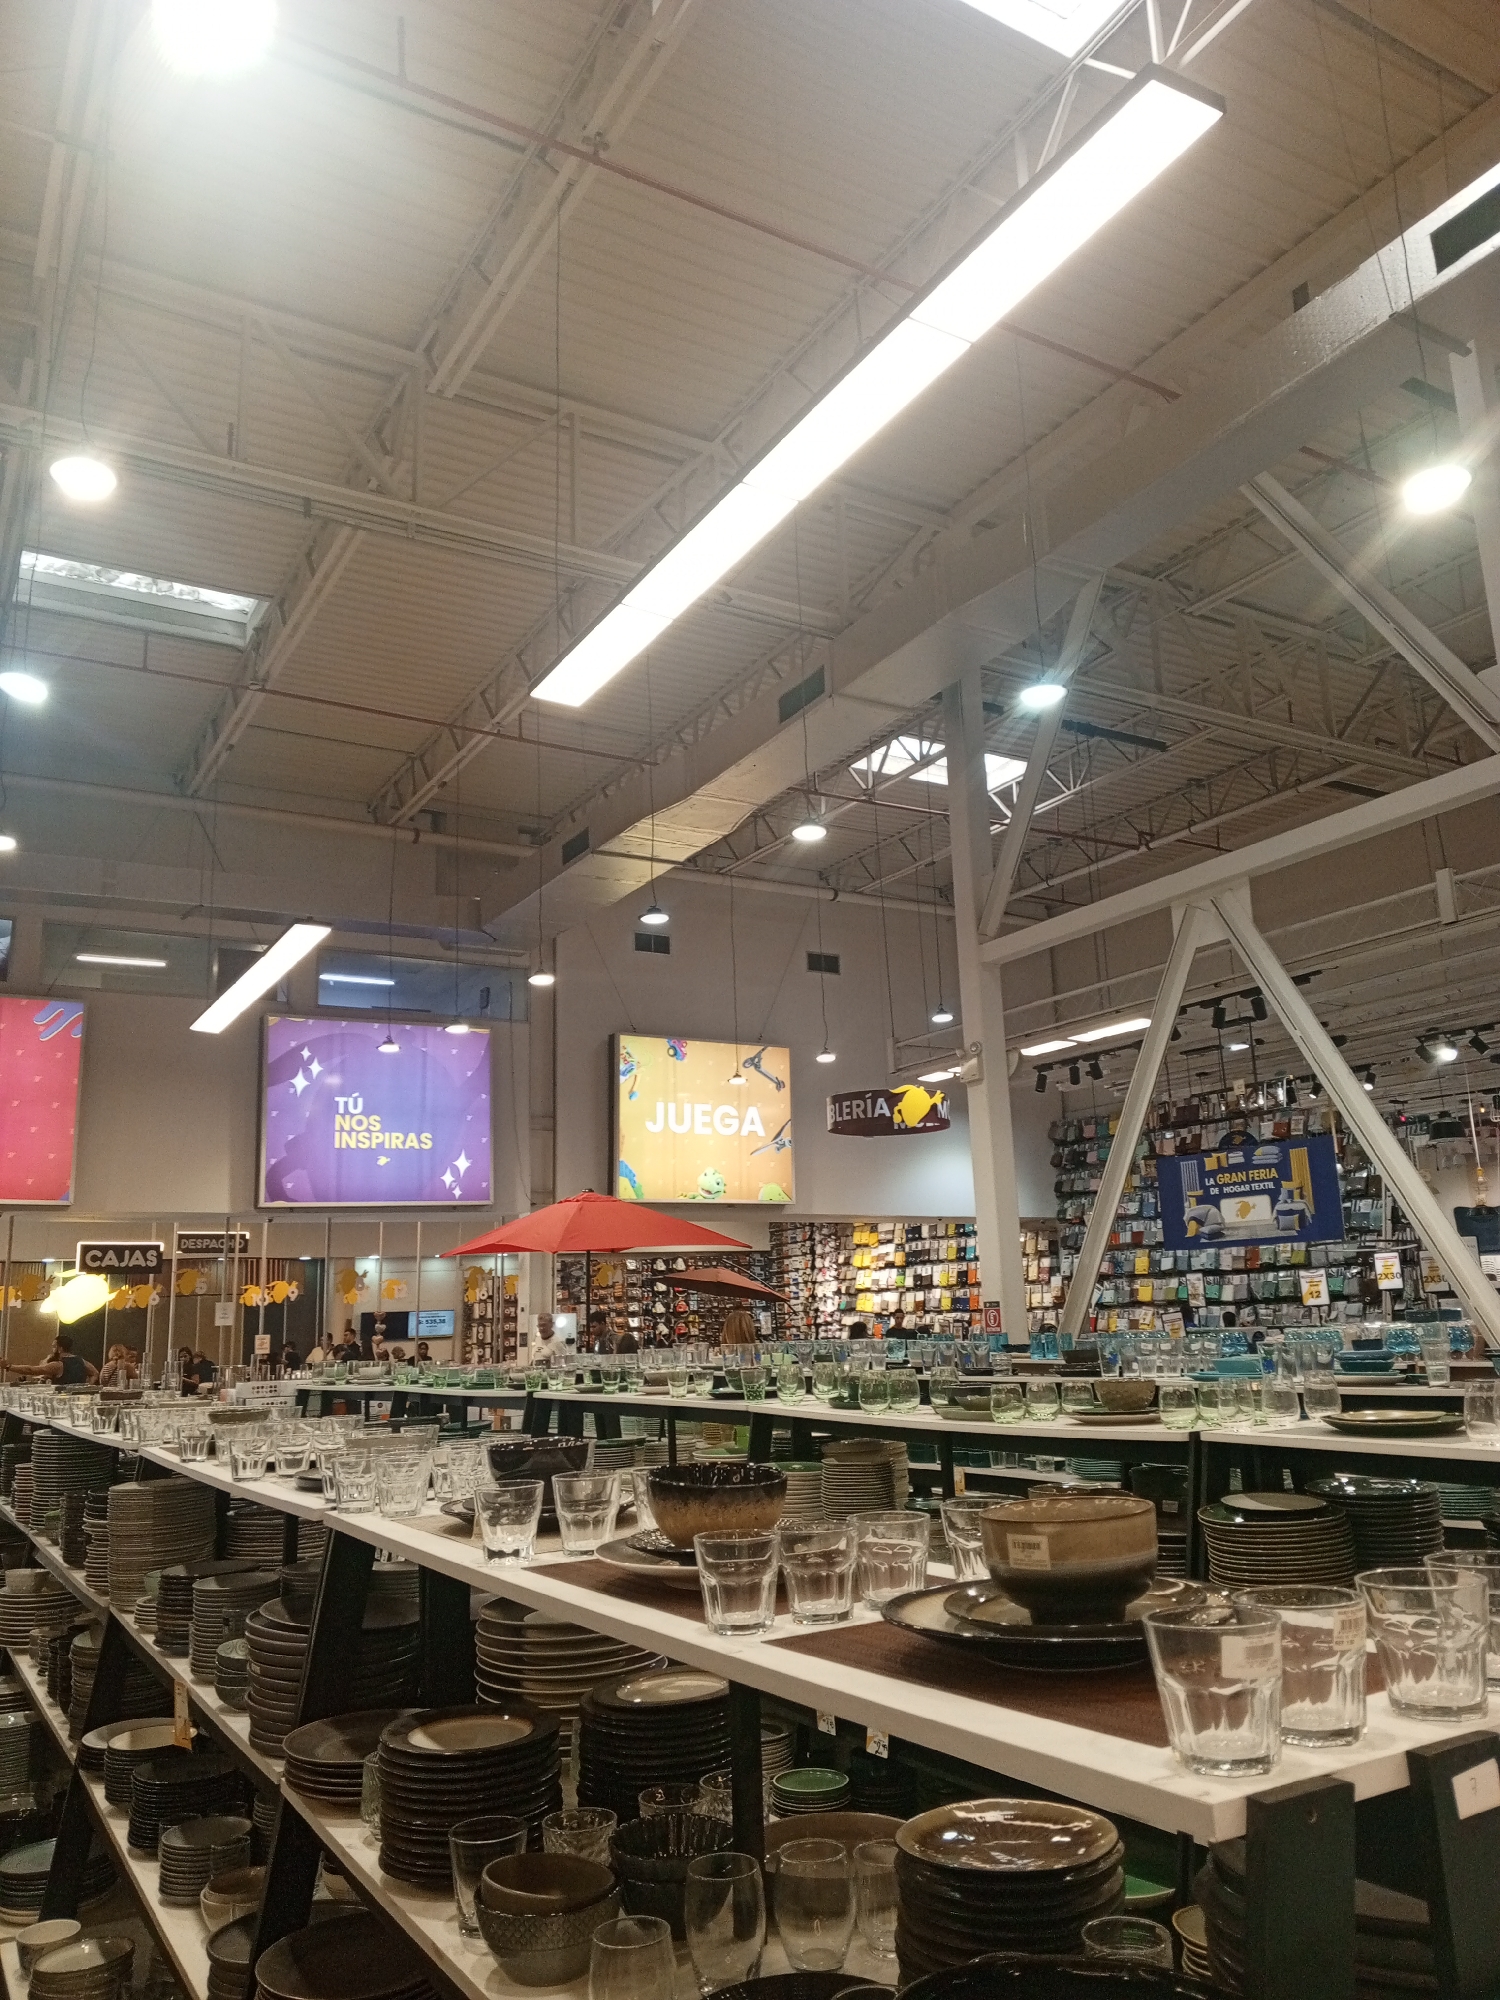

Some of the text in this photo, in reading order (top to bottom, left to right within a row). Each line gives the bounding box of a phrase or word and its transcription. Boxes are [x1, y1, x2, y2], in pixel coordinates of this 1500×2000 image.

[334, 1092, 363, 1114] TÚ
[334, 1114, 381, 1132] NOS
[645, 1101, 766, 1137] JUEGA
[334, 1131, 433, 1149] INSPIRAS
[1205, 1167, 1279, 1187] LA GRAN FERIA
[1209, 1181, 1276, 1195] DE HOGAR TEXTIL
[180, 1238, 246, 1249] DESPACHO
[84, 1249, 158, 1268] CAJAS
[1377, 1271, 1402, 1281] 2X30
[1308, 1290, 1322, 1299] 12
